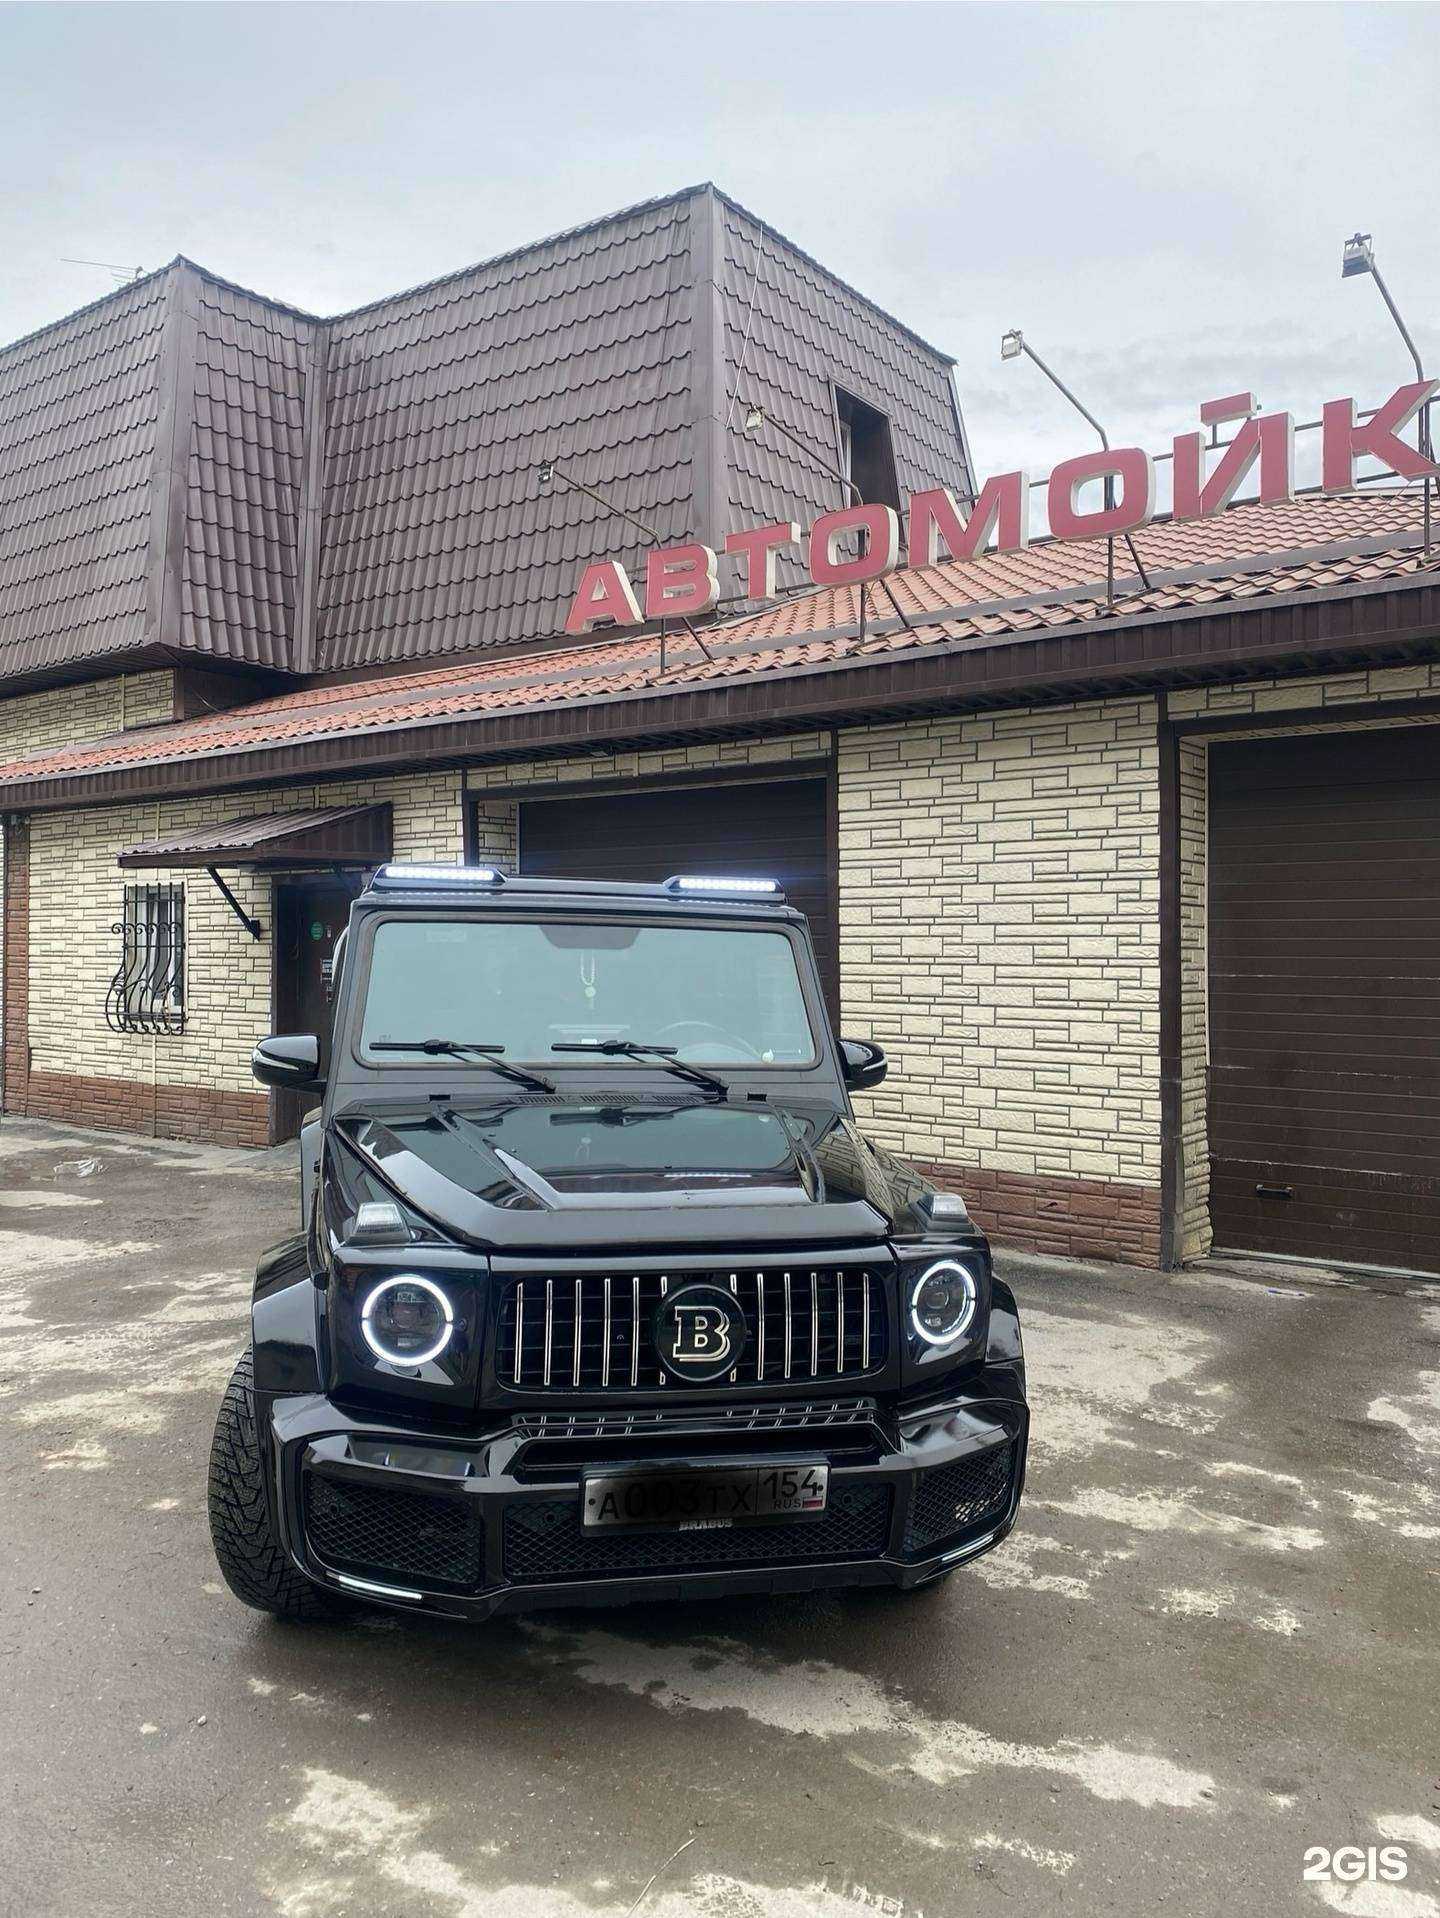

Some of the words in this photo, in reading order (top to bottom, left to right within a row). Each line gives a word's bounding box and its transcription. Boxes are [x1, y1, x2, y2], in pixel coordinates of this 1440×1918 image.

[566, 379, 1440, 635] АВТОМОЙК
[673, 1306, 731, 1361] B
[763, 1470, 818, 1499] 154
[774, 1498, 801, 1510] RUS
